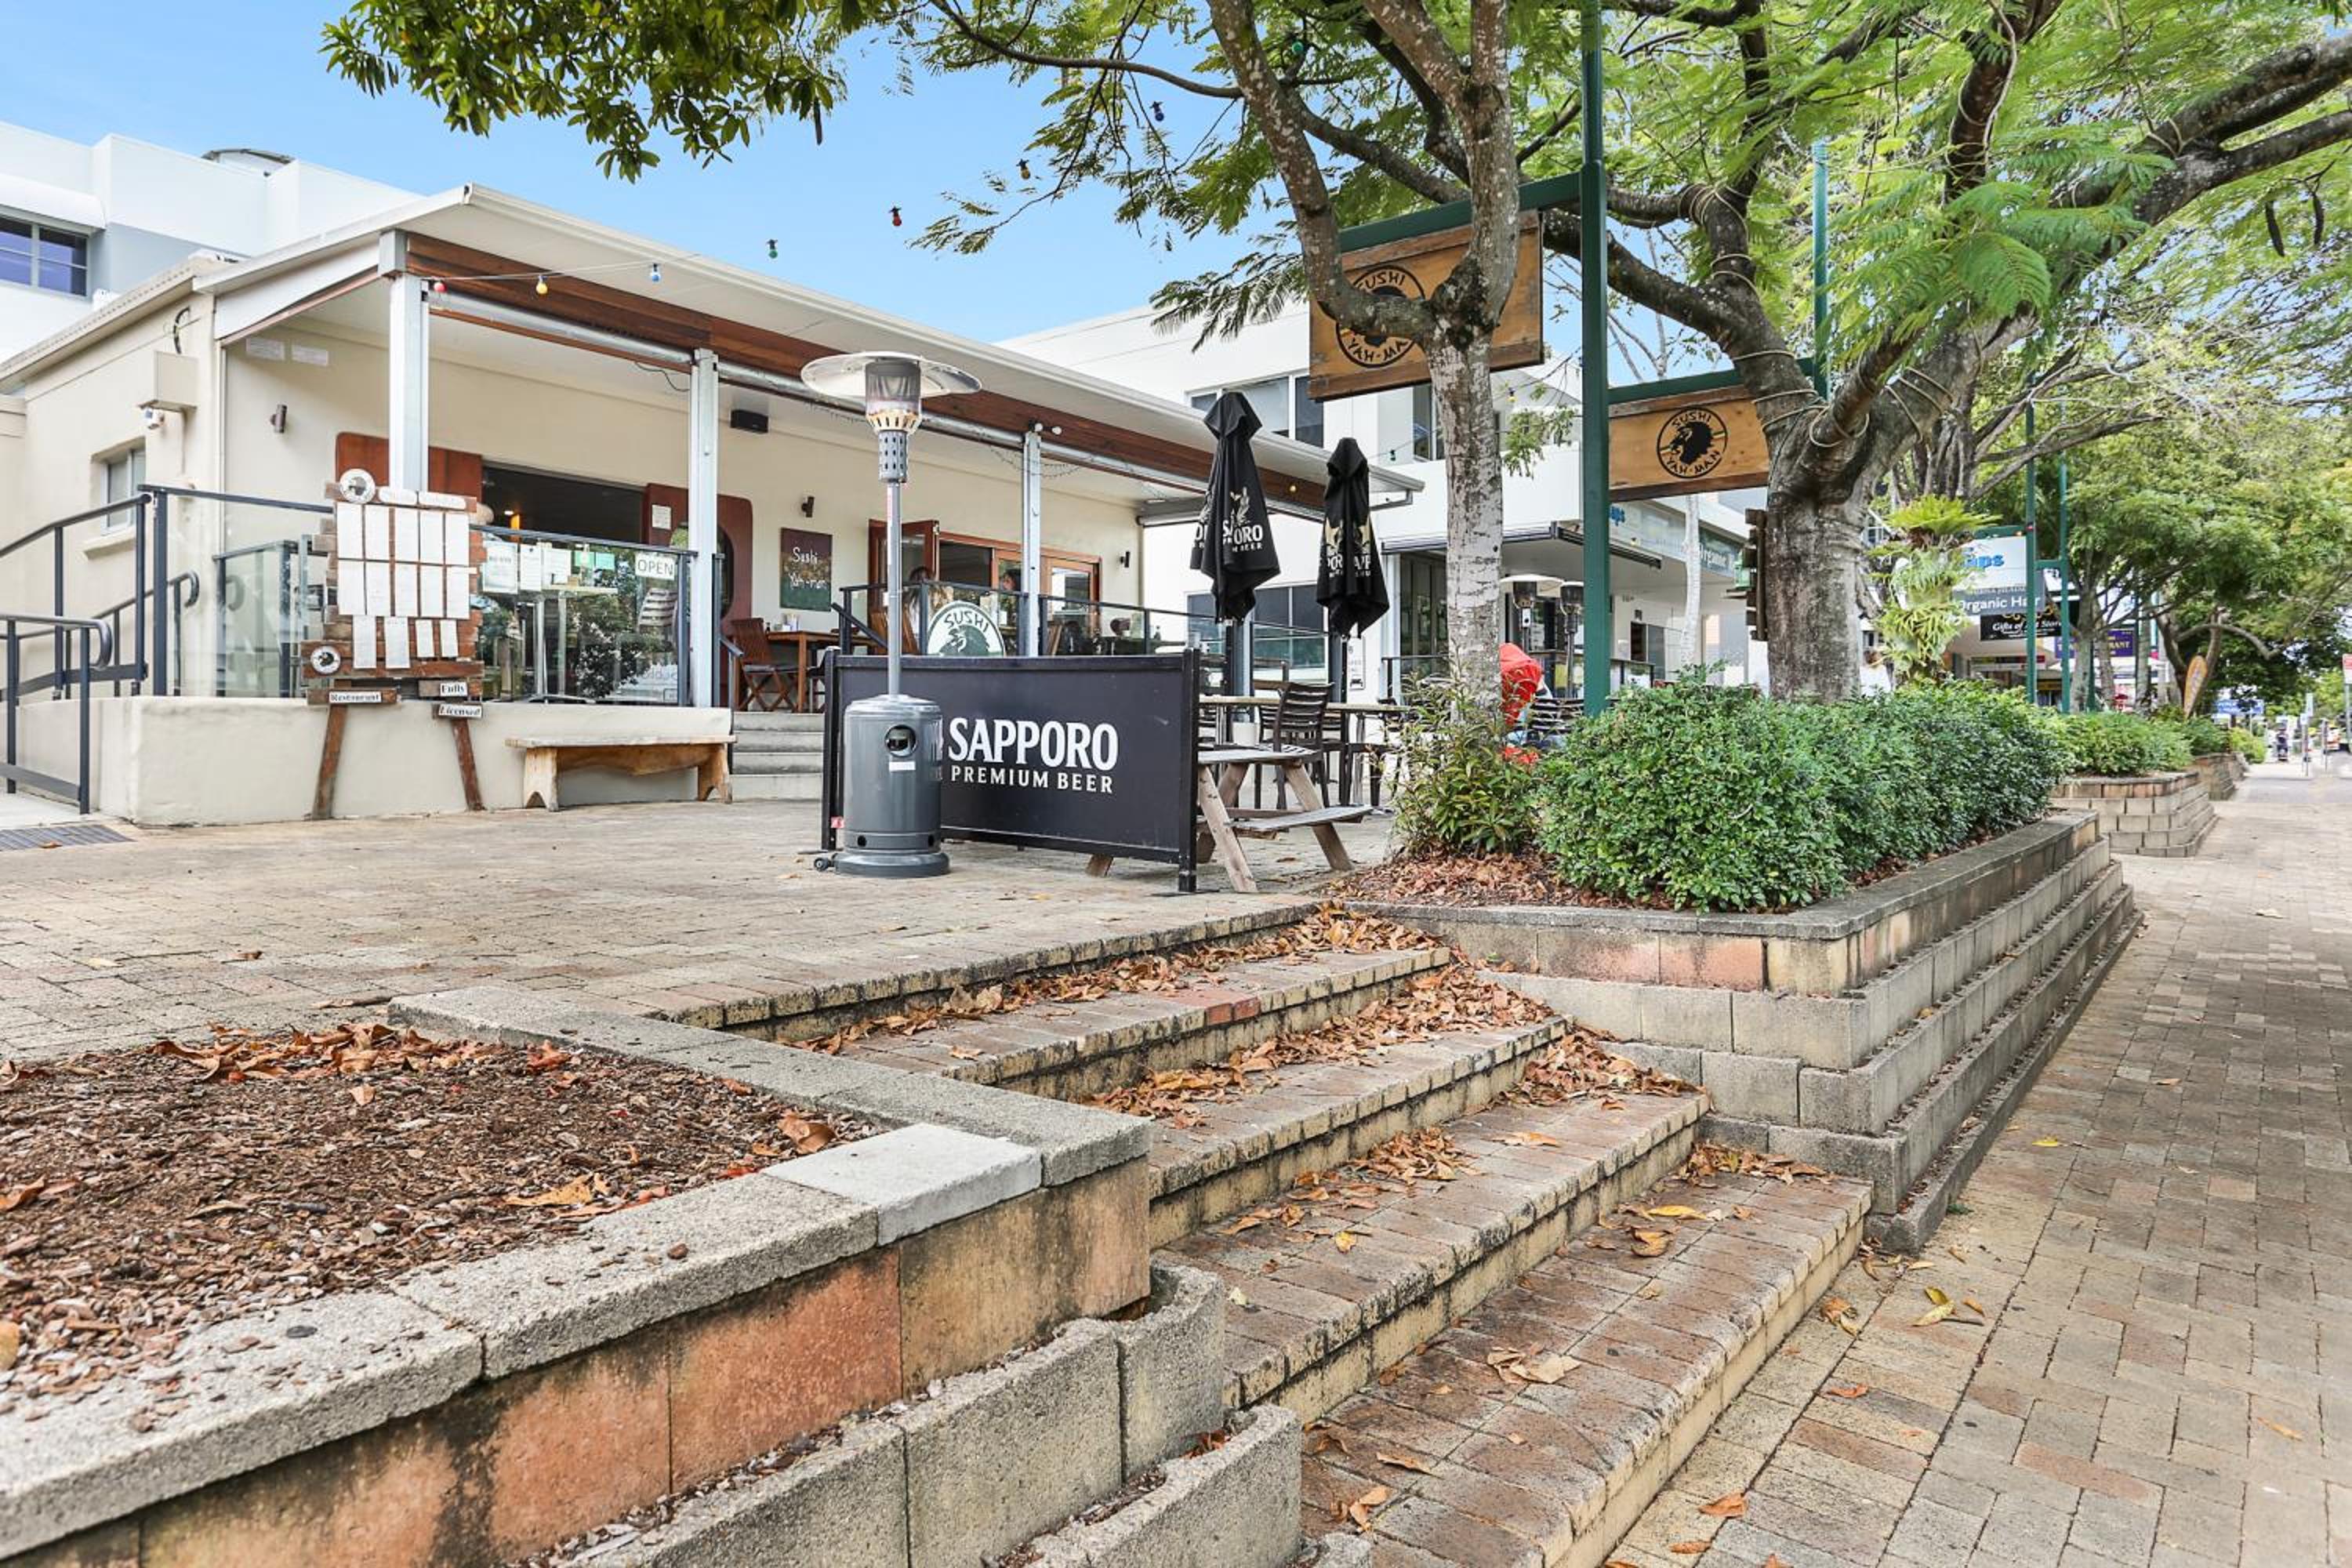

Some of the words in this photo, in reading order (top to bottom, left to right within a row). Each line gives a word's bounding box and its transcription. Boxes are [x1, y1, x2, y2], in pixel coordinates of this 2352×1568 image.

[1671, 411, 1712, 429] SUSHI
[793, 546, 818, 564] Sushi
[637, 557, 674, 575] OPEN
[2011, 595, 2042, 608] Har
[944, 610, 989, 633] SUSHI
[948, 717, 1119, 771] SAPPORO
[951, 764, 1049, 789] PREMIUM
[1058, 771, 1113, 794] BEER
